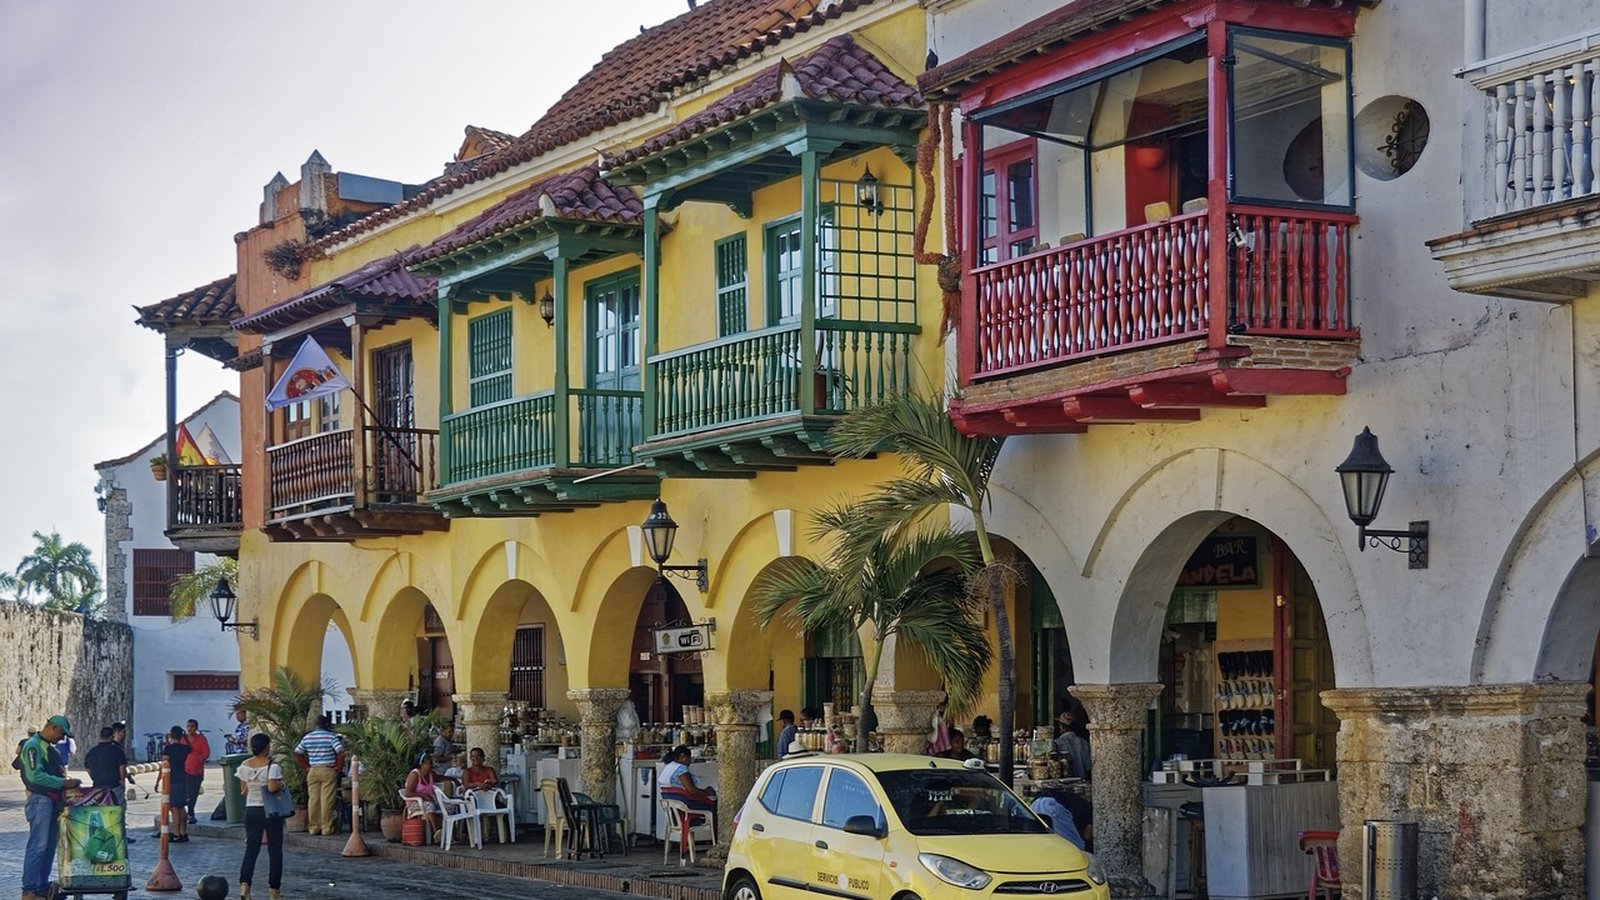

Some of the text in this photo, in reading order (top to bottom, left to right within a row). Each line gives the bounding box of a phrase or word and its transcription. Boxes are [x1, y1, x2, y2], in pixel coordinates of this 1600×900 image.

[1213, 539, 1248, 559] BAR
[1178, 563, 1257, 585] ANDELA
[817, 871, 838, 885] SERVICIO
